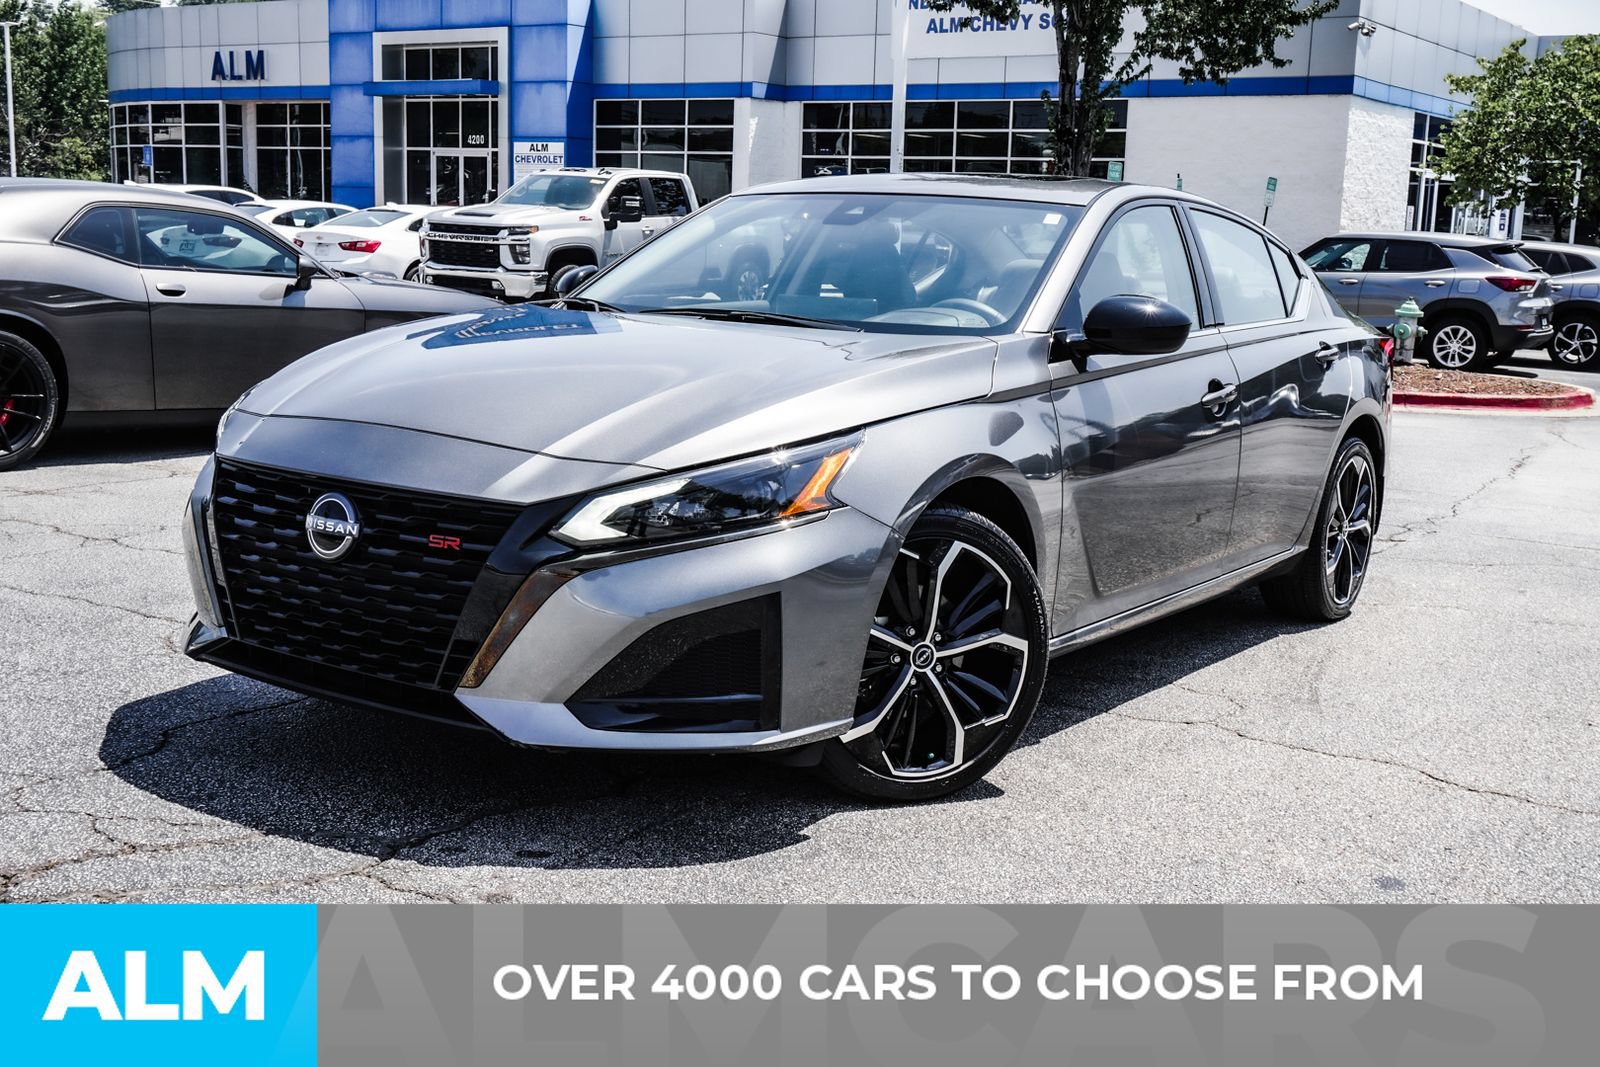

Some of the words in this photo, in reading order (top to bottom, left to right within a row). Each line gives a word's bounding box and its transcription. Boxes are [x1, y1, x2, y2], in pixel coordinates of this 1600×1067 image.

[926, 17, 964, 34] ALM
[211, 50, 265, 80] ALM
[467, 135, 485, 144] 4200
[529, 143, 549, 152] ALM
[515, 155, 563, 164] CHEVROLET
[305, 514, 359, 536] NISSAN
[428, 534, 461, 550] SR
